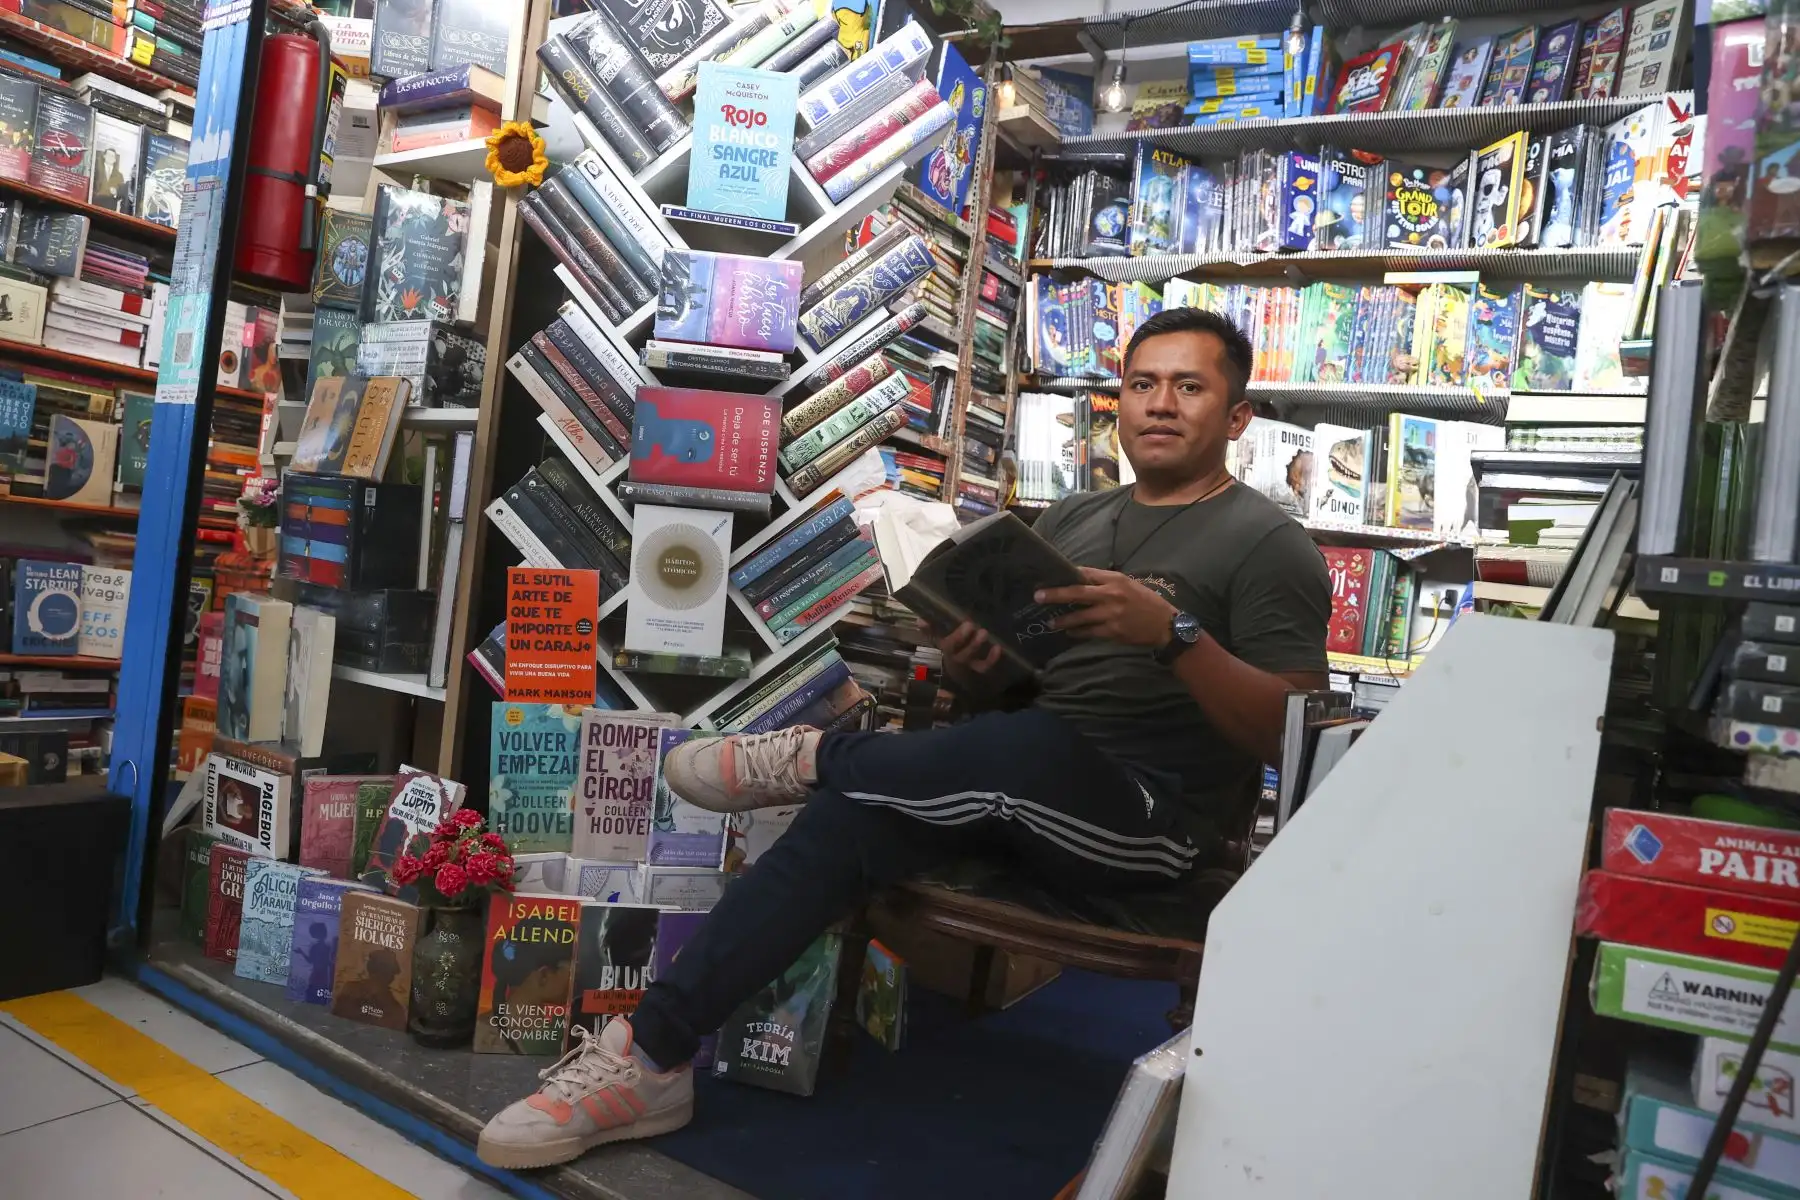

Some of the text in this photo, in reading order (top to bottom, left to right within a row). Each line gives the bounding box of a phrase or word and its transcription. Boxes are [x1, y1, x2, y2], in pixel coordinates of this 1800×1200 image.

[736, 81, 760, 91] CASEY
[726, 90, 769, 101] McQUISTON
[709, 124, 778, 149] BLANCO
[713, 144, 779, 168] SANGRE
[719, 163, 760, 184] AZUL
[1343, 176, 1363, 187] PARA
[1395, 187, 1433, 203] GRAND
[1401, 201, 1438, 216] TOUR
[678, 210, 777, 232] AL FINAL MUEREN LOS DOS
[420, 234, 440, 243] Gabriel
[413, 262, 439, 272] SOLEDAD
[325, 311, 356, 321] TAROT
[558, 416, 586, 444] Alba
[729, 407, 744, 477] Deja de ser tú
[756, 405, 772, 484] JOE DISPENZA
[1281, 430, 1314, 449] DINOS
[665, 557, 696, 567] HÁBITOS
[50, 567, 80, 580] LEAN
[662, 566, 698, 576] ATÓMICOS
[25, 578, 80, 592] STARTUP
[512, 573, 574, 587] EL SUTIL
[1743, 575, 1763, 588] EL
[511, 590, 573, 603] ARTE DE
[778, 578, 803, 602] regreso
[803, 582, 861, 626] Malibu Renace
[82, 611, 113, 623] EFF
[510, 606, 562, 619] QUE TE
[84, 624, 120, 639] ZOS
[510, 622, 573, 636] IMPORTE
[509, 639, 531, 651] UN
[508, 688, 593, 699] MARK MANSON
[765, 679, 800, 706] CHARLOTTE
[499, 731, 567, 753] VOLVER
[587, 722, 660, 750] ROMPE
[585, 749, 609, 774] EL
[205, 762, 217, 829] ELLIOT PAGE
[512, 795, 568, 810] COLLEEN
[402, 792, 436, 817] LUPIN
[604, 805, 646, 818] COLLEEN
[259, 781, 275, 851] PAGEBOY
[1714, 835, 1779, 855] ANIMAL
[1699, 846, 1800, 888] PAIR
[254, 872, 297, 896] ALICIA
[317, 892, 335, 902] Jane
[302, 898, 333, 912] Orgullo
[508, 903, 581, 922] ISABEL
[355, 915, 406, 937] SHERLOCK
[354, 925, 405, 951] HOLMES
[1682, 980, 1765, 1008] WARNIN
[498, 1003, 566, 1017] EL VIENTO
[489, 1015, 553, 1029] CONOCE
[500, 1029, 559, 1041] NOMBRE
[746, 1022, 796, 1042] TEORÍA
[740, 1037, 792, 1067] KIM
